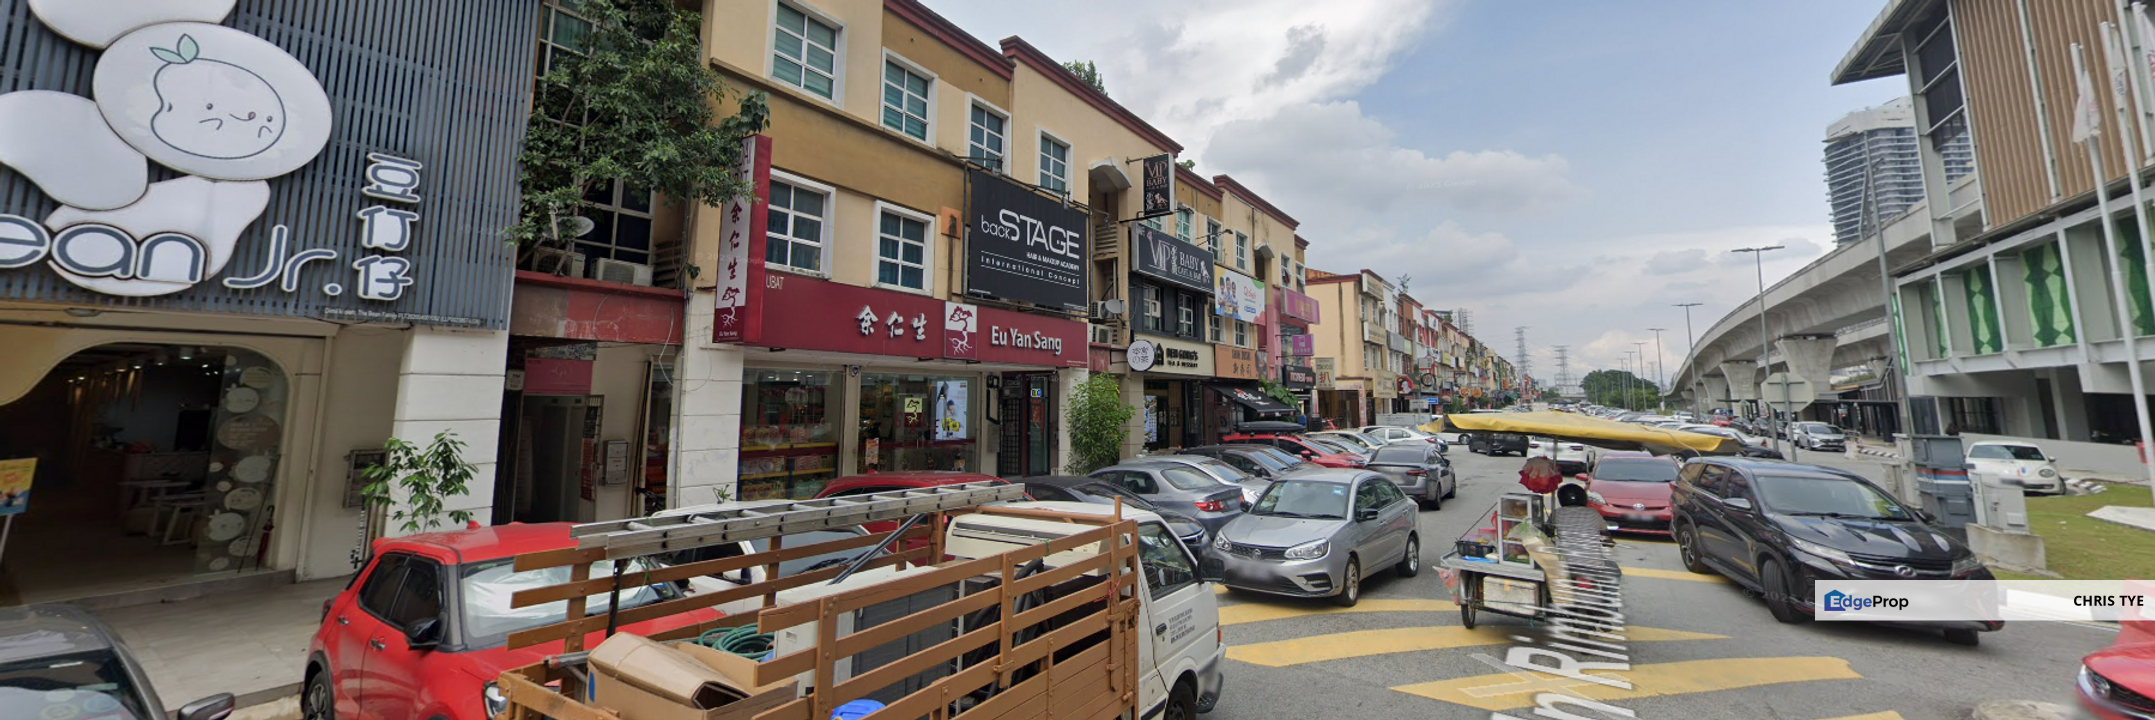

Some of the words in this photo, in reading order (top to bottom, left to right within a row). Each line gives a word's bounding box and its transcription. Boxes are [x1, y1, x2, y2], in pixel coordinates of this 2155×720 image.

[1146, 175, 1168, 187] BABY
[727, 201, 743, 281] 余仁生
[222, 224, 343, 296] Jr.
[981, 255, 1044, 277] International
[1048, 271, 1080, 285] Concept
[1060, 261, 1079, 271] ACADEMY
[1179, 251, 1200, 270] BABY
[766, 274, 784, 289] UBAT
[855, 305, 927, 341] 余仁生
[991, 325, 1007, 346] Eu
[1009, 327, 1031, 349] Yan
[1033, 330, 1062, 356] Sang
